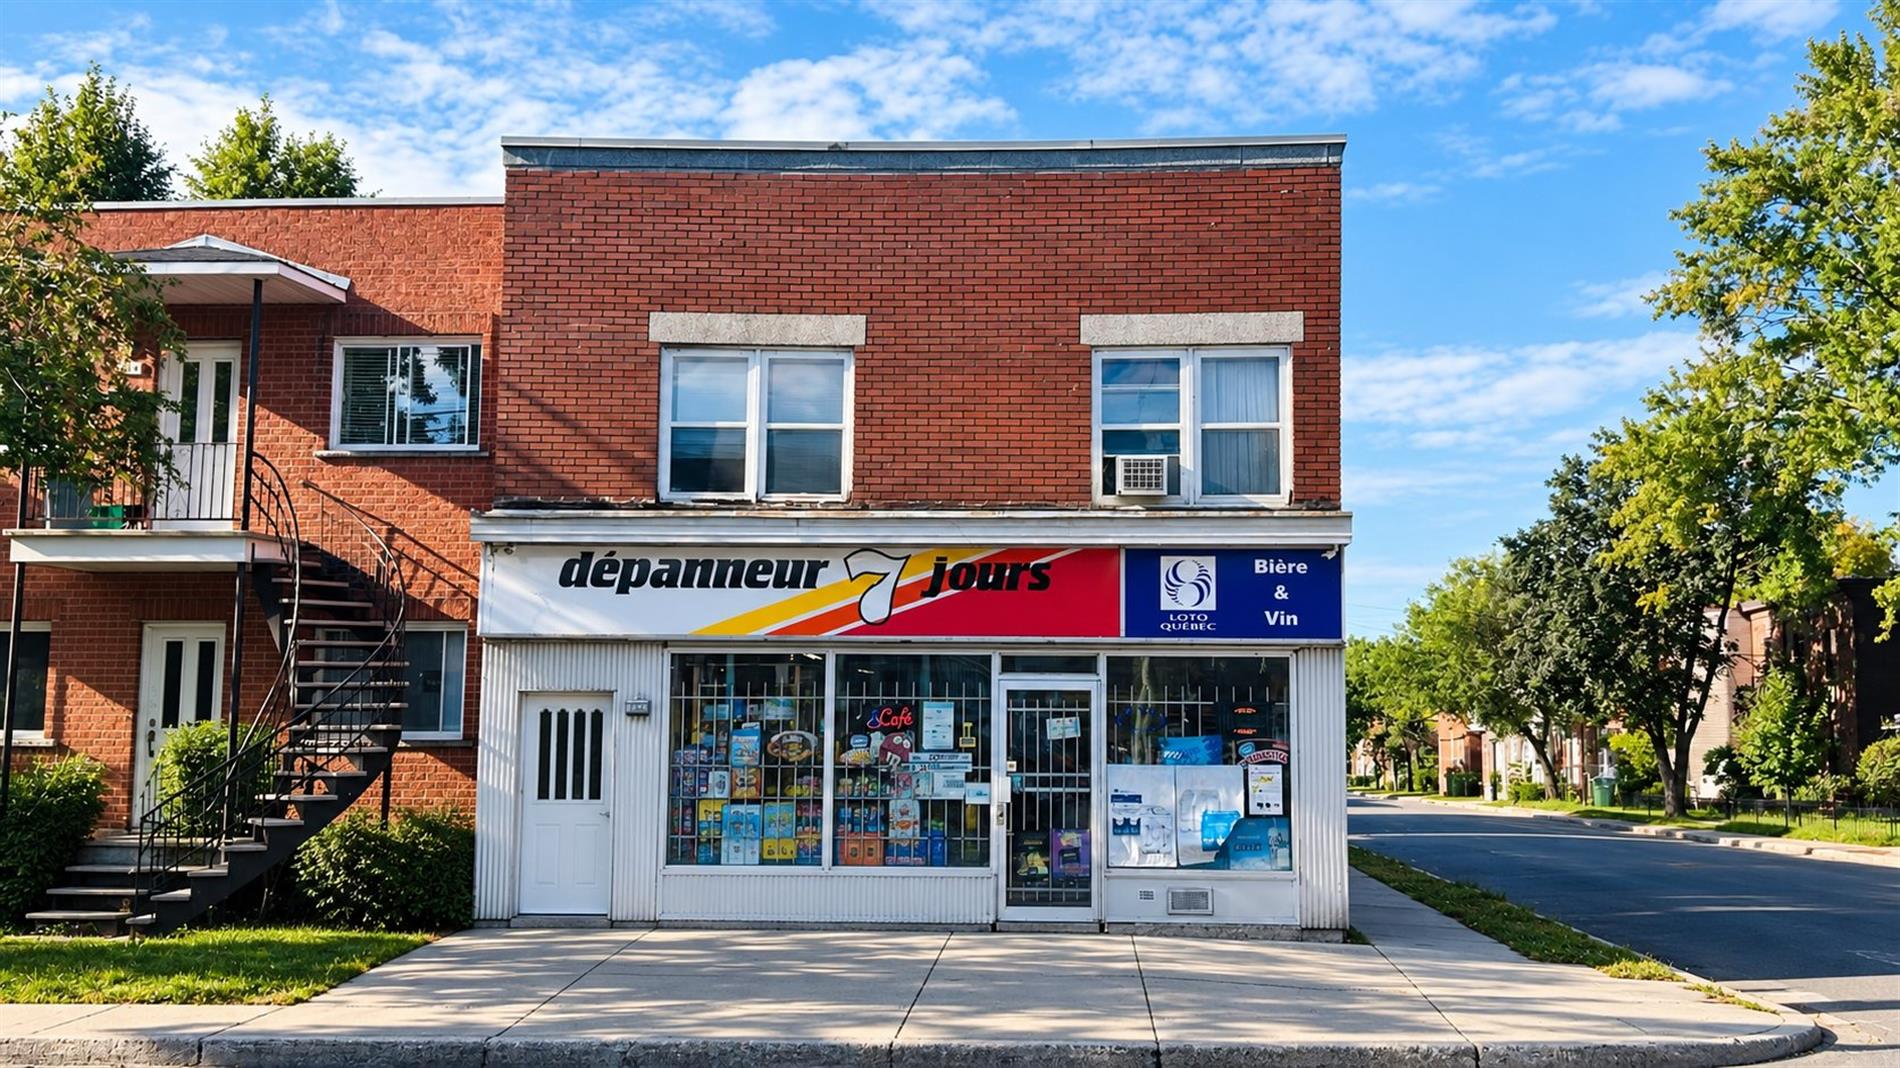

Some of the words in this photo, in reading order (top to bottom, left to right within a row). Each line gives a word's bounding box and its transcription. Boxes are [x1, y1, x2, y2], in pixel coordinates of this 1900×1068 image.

[1254, 558, 1308, 574] Bière
[558, 550, 830, 594] dépanneur
[844, 548, 911, 625] 7
[920, 556, 1051, 597] jours
[1274, 584, 1289, 600] &
[1169, 613, 1208, 622] LOTO
[1264, 610, 1299, 626] Vin
[1160, 621, 1217, 632] QUÉBEC
[880, 706, 913, 729] Café
